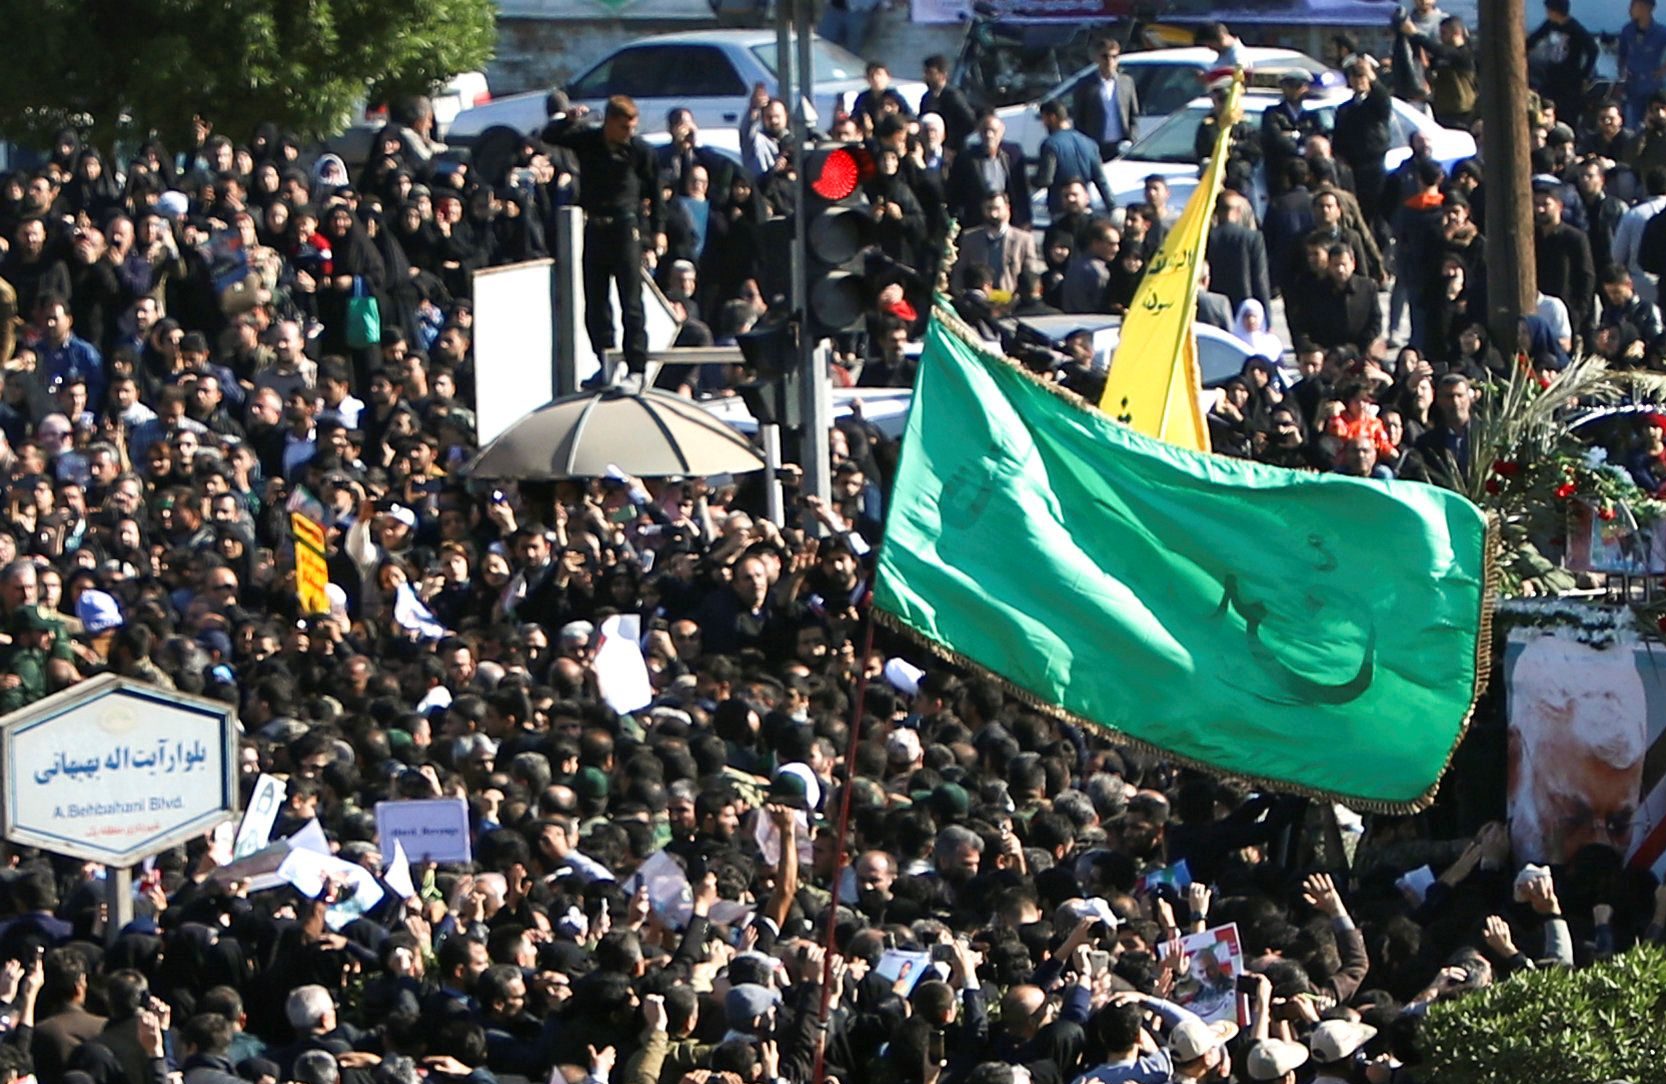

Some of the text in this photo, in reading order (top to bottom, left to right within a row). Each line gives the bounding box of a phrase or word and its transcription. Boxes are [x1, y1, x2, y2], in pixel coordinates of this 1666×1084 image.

[33, 738, 207, 785] بلوار آیت اله بهبهانی
[53, 796, 186, 820] A.Behbahani Blvd.
